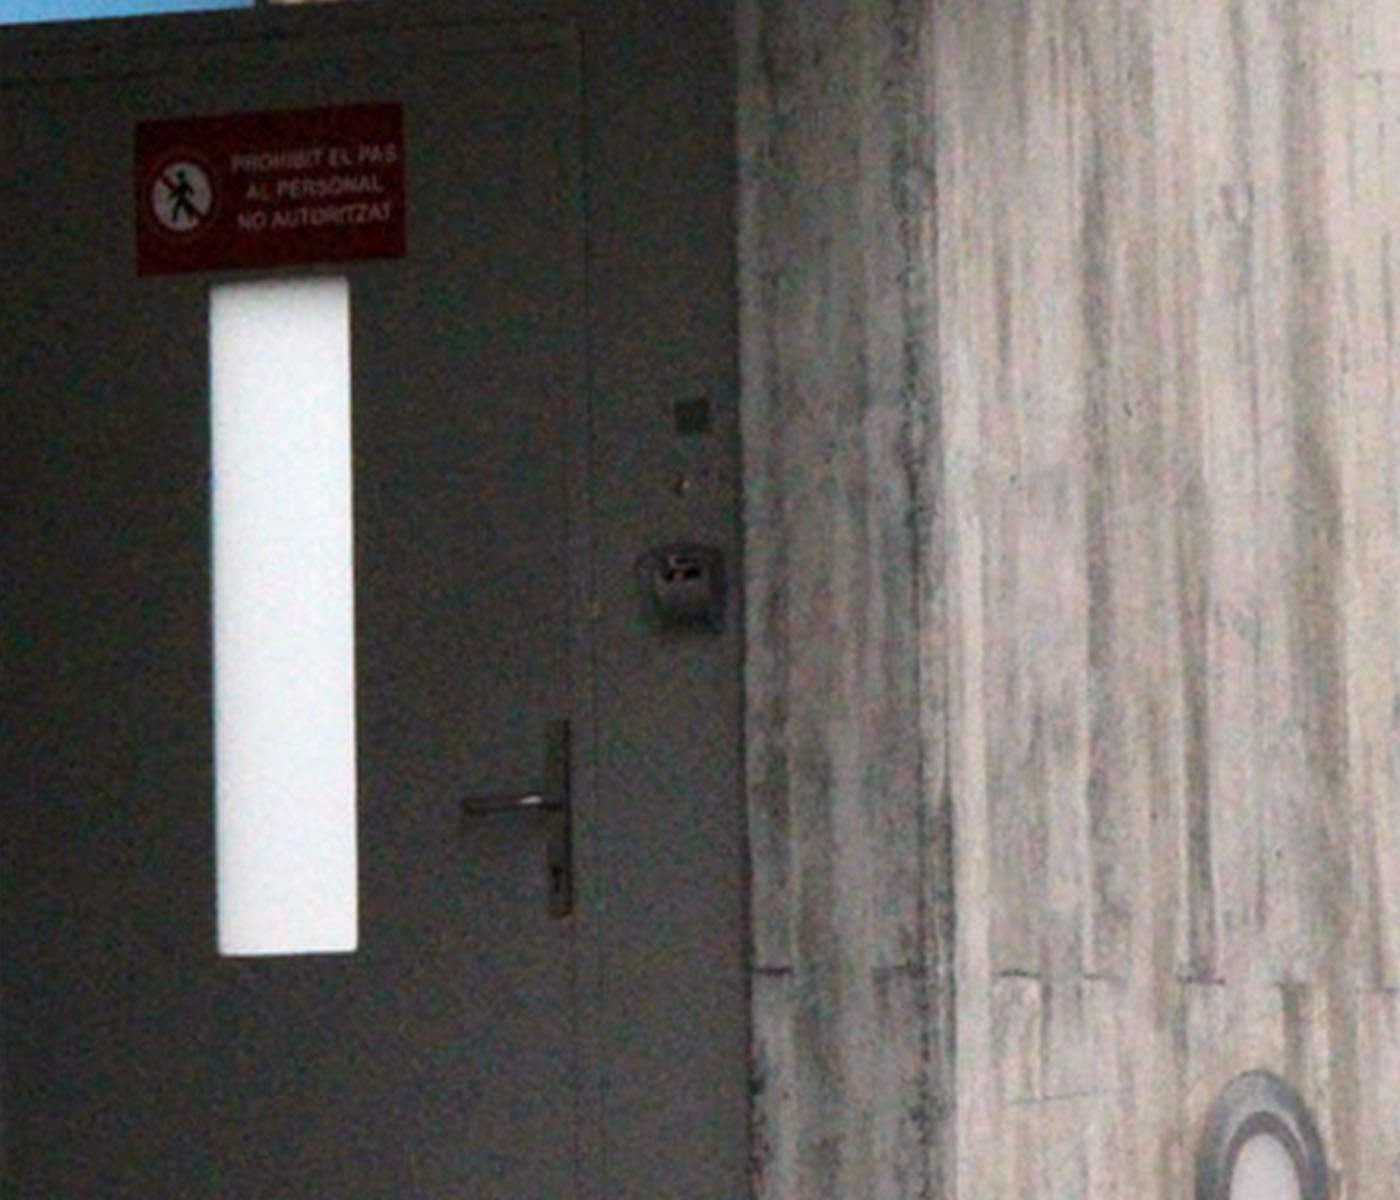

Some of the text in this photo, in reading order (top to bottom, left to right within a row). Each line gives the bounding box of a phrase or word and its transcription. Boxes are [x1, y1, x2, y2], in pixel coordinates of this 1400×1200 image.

[231, 143, 398, 173] PROHIBIT EL PAS
[246, 174, 384, 201] AL PERSONAL
[237, 201, 392, 232] NO AUTORITZAT
